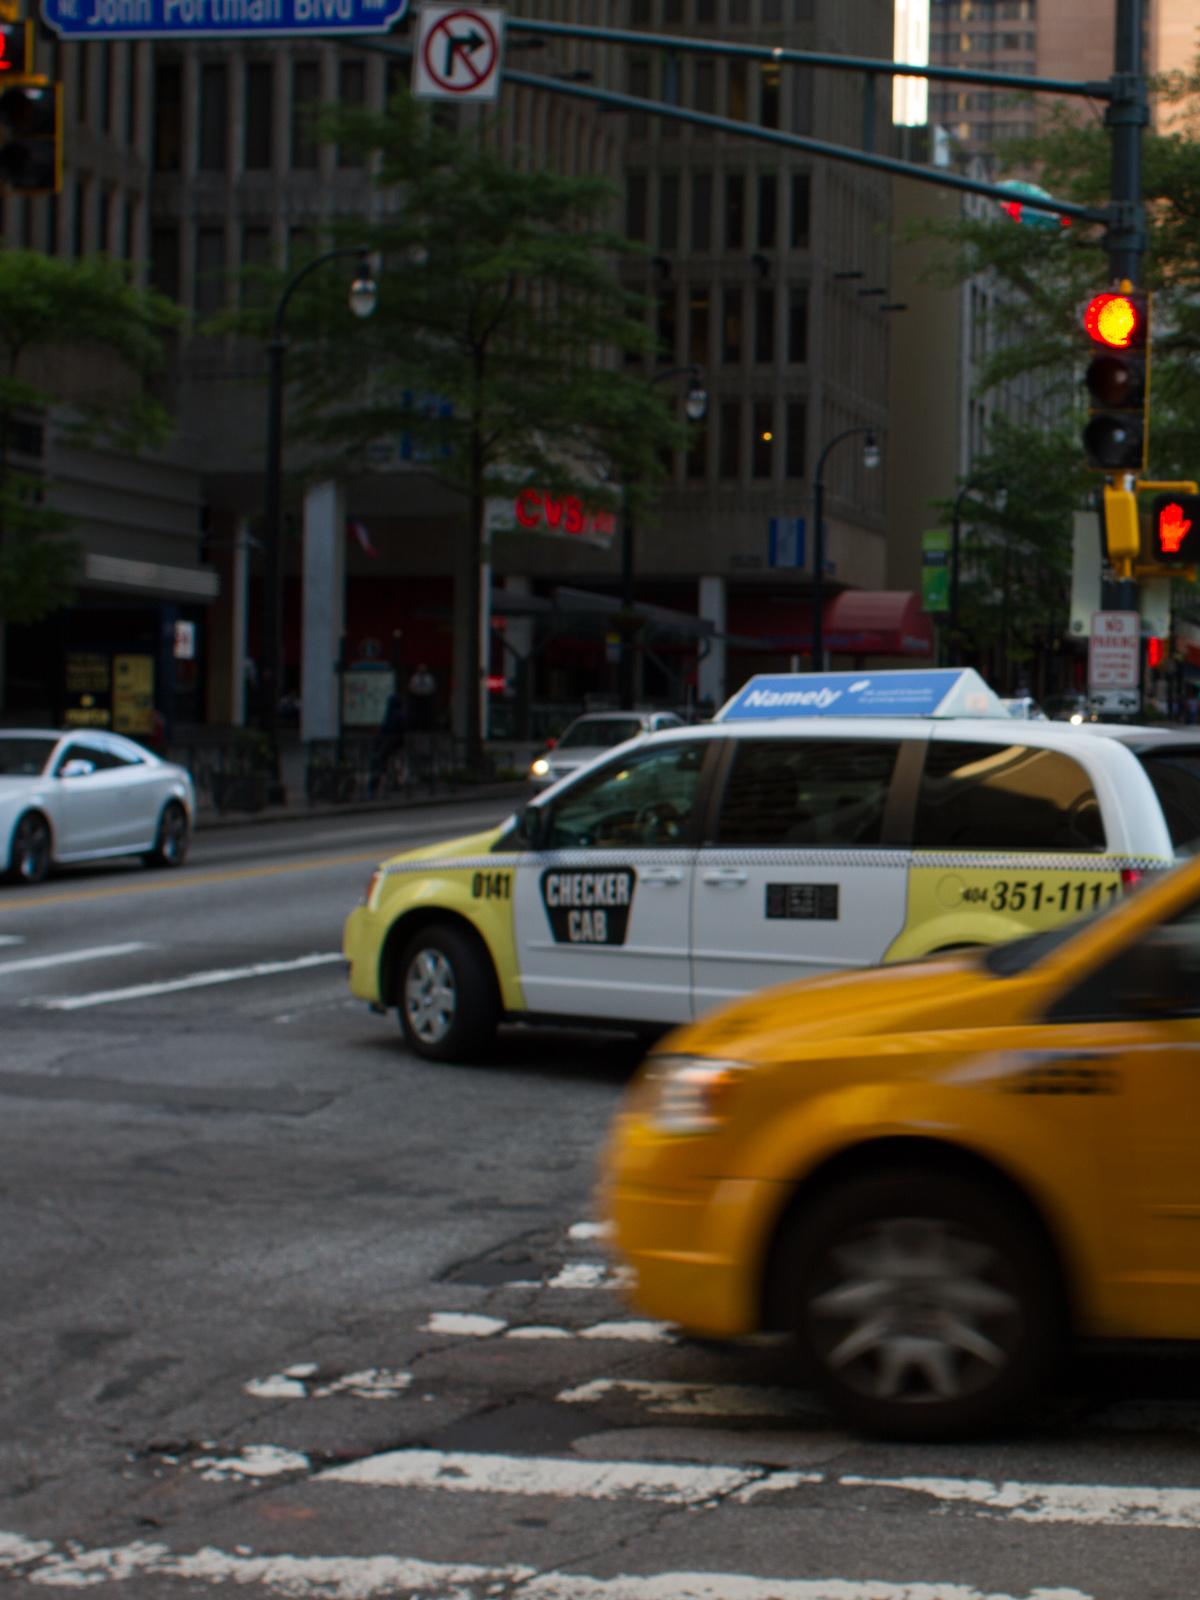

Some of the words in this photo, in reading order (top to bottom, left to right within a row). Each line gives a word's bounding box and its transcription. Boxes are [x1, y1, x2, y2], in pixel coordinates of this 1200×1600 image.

[86, 0, 152, 25] John
[162, 0, 281, 23] Portman
[743, 687, 842, 708] Namely
[473, 872, 511, 898] 0141
[546, 873, 630, 907] CHECKER
[990, 880, 1119, 912] 351-1111
[568, 909, 608, 942] CAB
